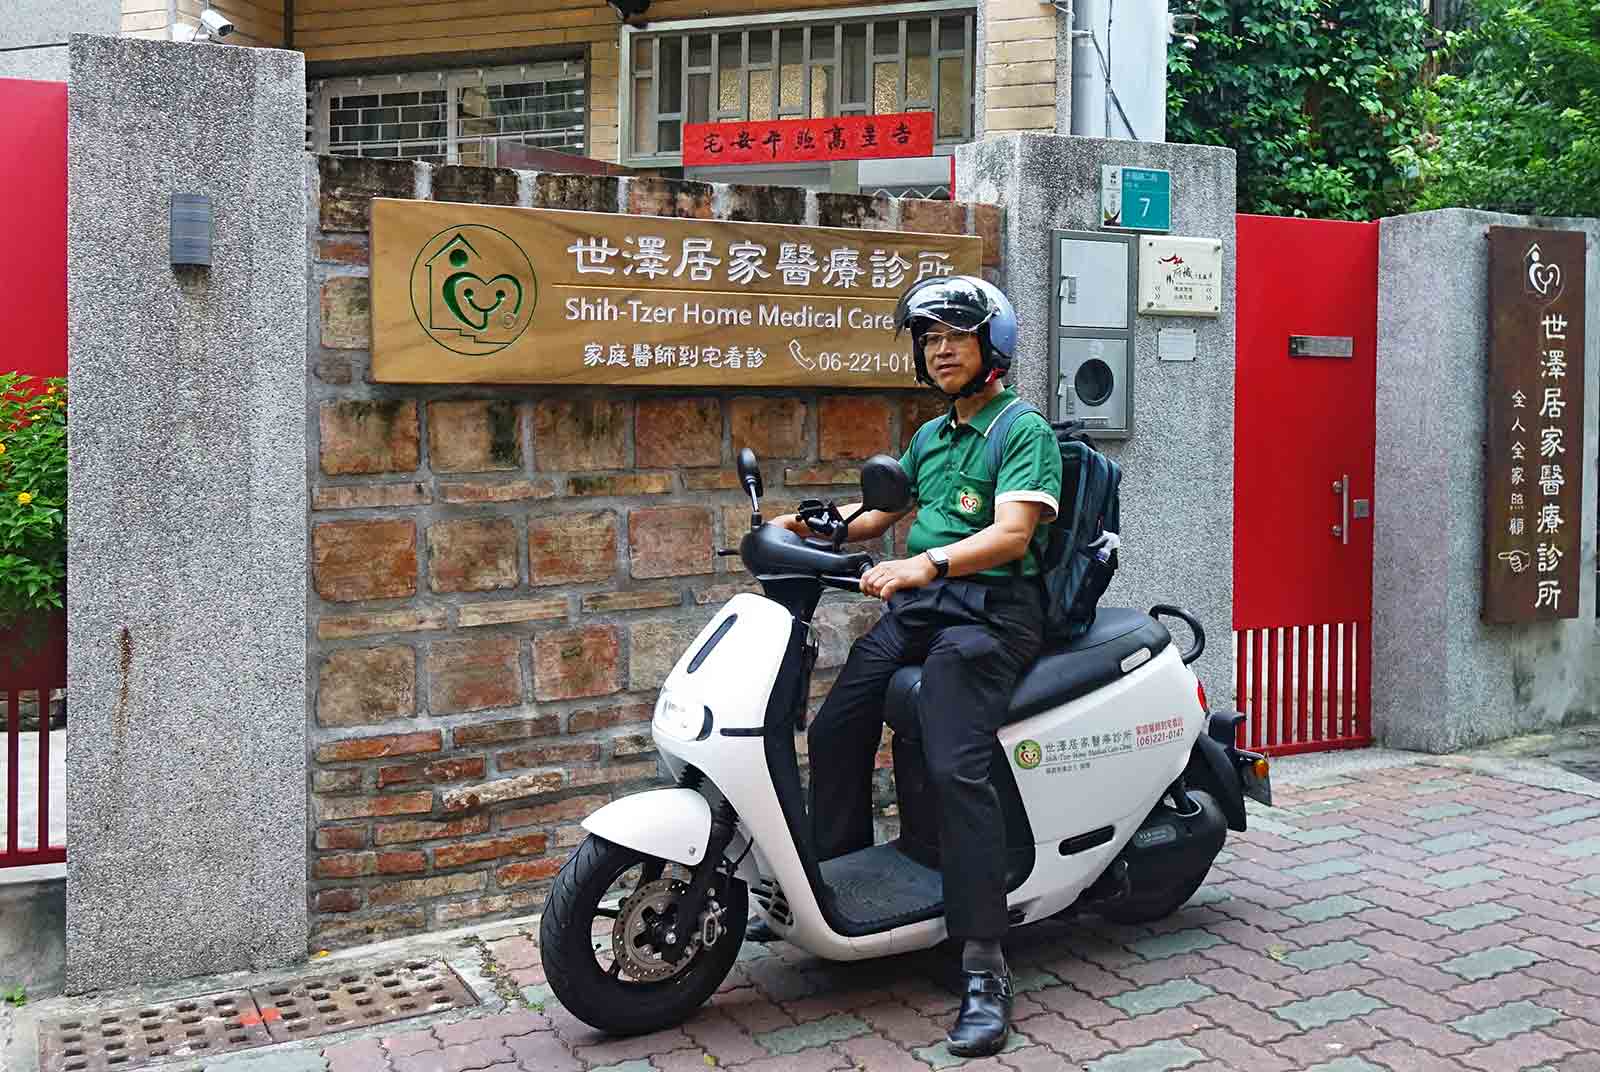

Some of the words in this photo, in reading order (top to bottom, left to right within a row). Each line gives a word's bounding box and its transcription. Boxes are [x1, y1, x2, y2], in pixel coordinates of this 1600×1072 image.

[1139, 197, 1151, 217] 7
[567, 236, 954, 288] 世澤居家醫療診所
[565, 297, 677, 323] Shih-Tzer
[683, 303, 752, 325] Home
[758, 304, 841, 328] Medical
[848, 307, 895, 329] Care
[584, 342, 768, 369] 家庭醫師到宅看診
[818, 351, 916, 374] 06-221-01
[1535, 313, 1568, 609] 世澤居家醫療診所
[1136, 727, 1184, 747] (06)221-0147
